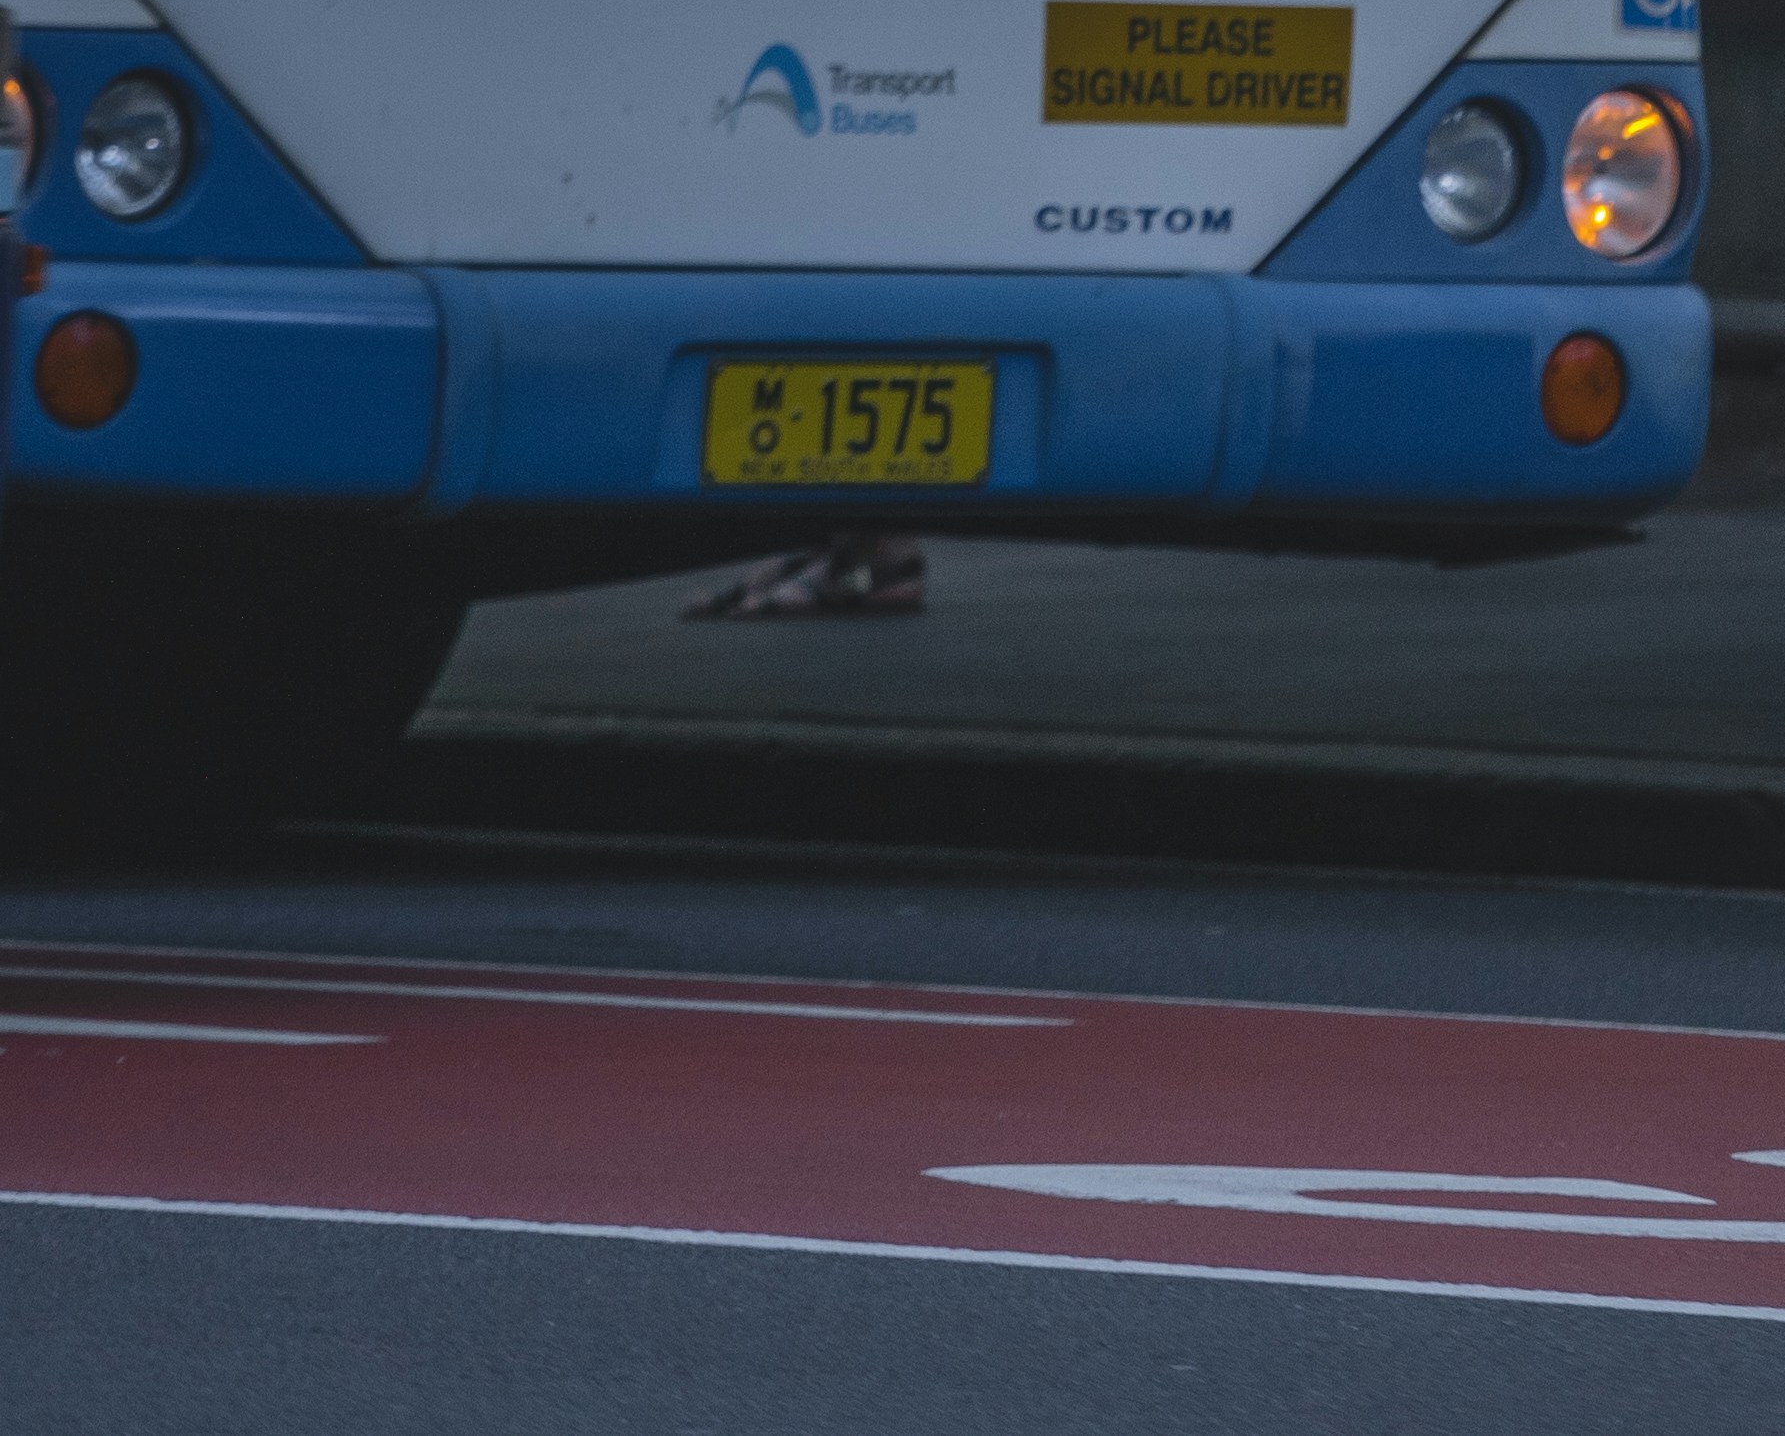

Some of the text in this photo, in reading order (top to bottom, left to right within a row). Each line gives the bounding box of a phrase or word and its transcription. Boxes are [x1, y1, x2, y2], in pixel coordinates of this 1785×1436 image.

[1126, 16, 1277, 58] PLEASE
[827, 64, 956, 103] Transport
[1051, 66, 1345, 111] SIGNAL DRIVER
[831, 102, 918, 135] Buses
[1033, 205, 1235, 235] CUSTOM
[821, 378, 957, 455] 1575
